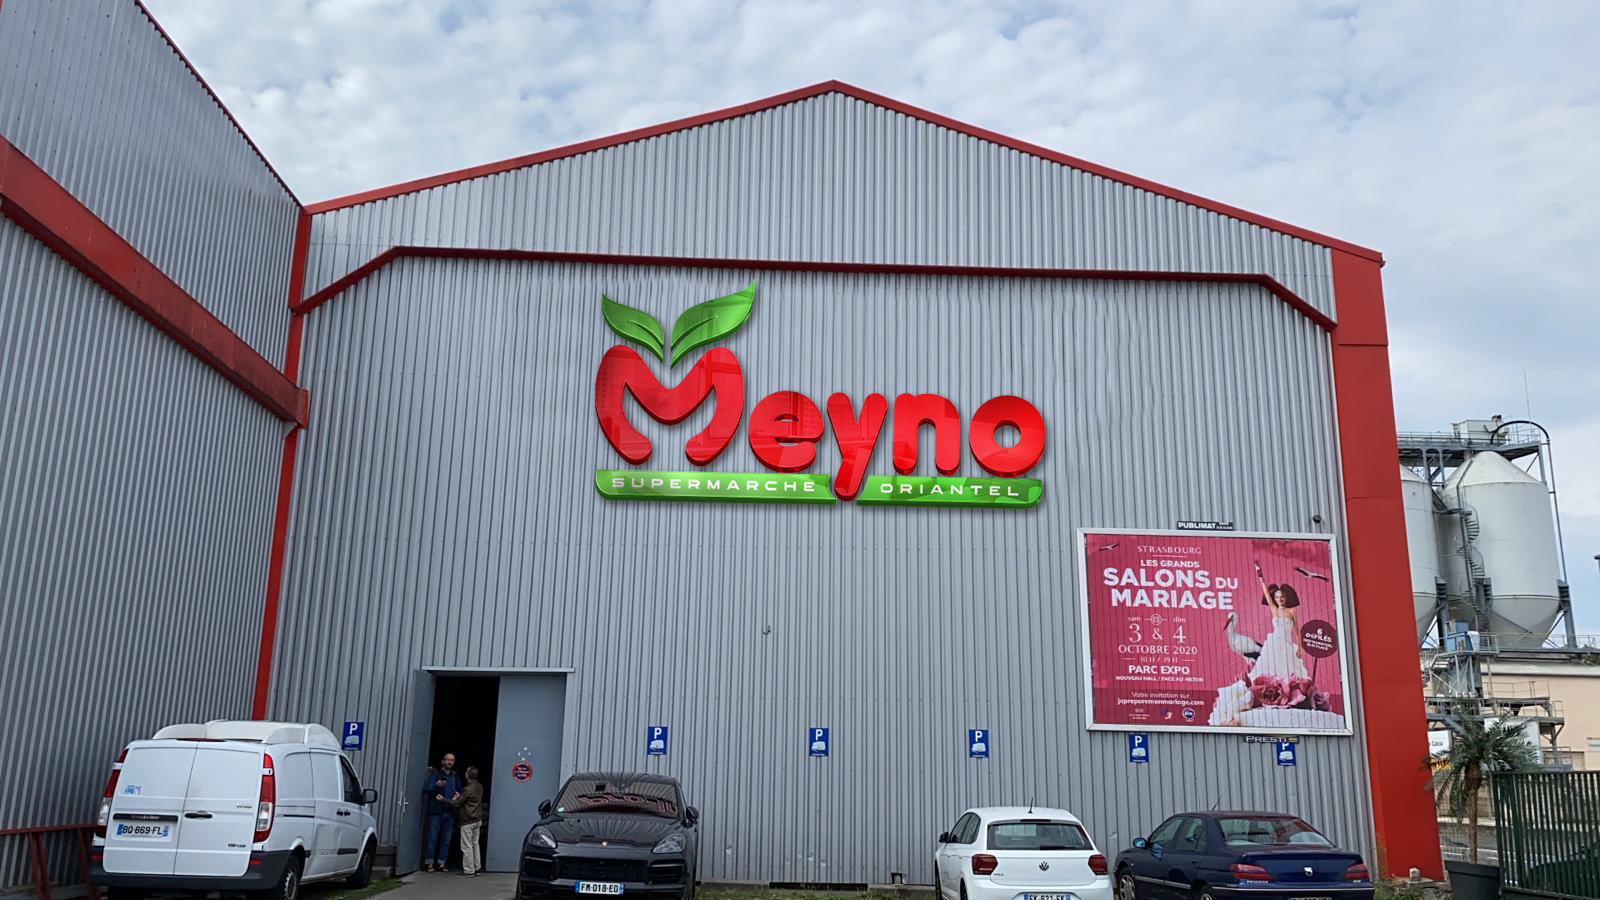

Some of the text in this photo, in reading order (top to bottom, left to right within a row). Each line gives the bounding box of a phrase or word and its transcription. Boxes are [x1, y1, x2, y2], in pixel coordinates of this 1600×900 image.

[595, 344, 1046, 501] Meyno
[611, 477, 1020, 497] SUPERMARCHE ORIANTEL
[1136, 545, 1202, 554] STRASBOURG
[1140, 559, 1200, 568] LES GRANDS
[1103, 567, 1239, 589] SALONS DU
[1111, 588, 1234, 610] MARIAGE
[1129, 623, 1187, 643] 3 & 4
[1118, 644, 1198, 655] OCTOBRE 2020
[1128, 664, 1190, 675] PARC EXPO
[350, 723, 359, 734] P
[654, 728, 662, 739] P
[815, 729, 823, 740] P
[975, 731, 983, 742] P
[1134, 735, 1142, 747] P
